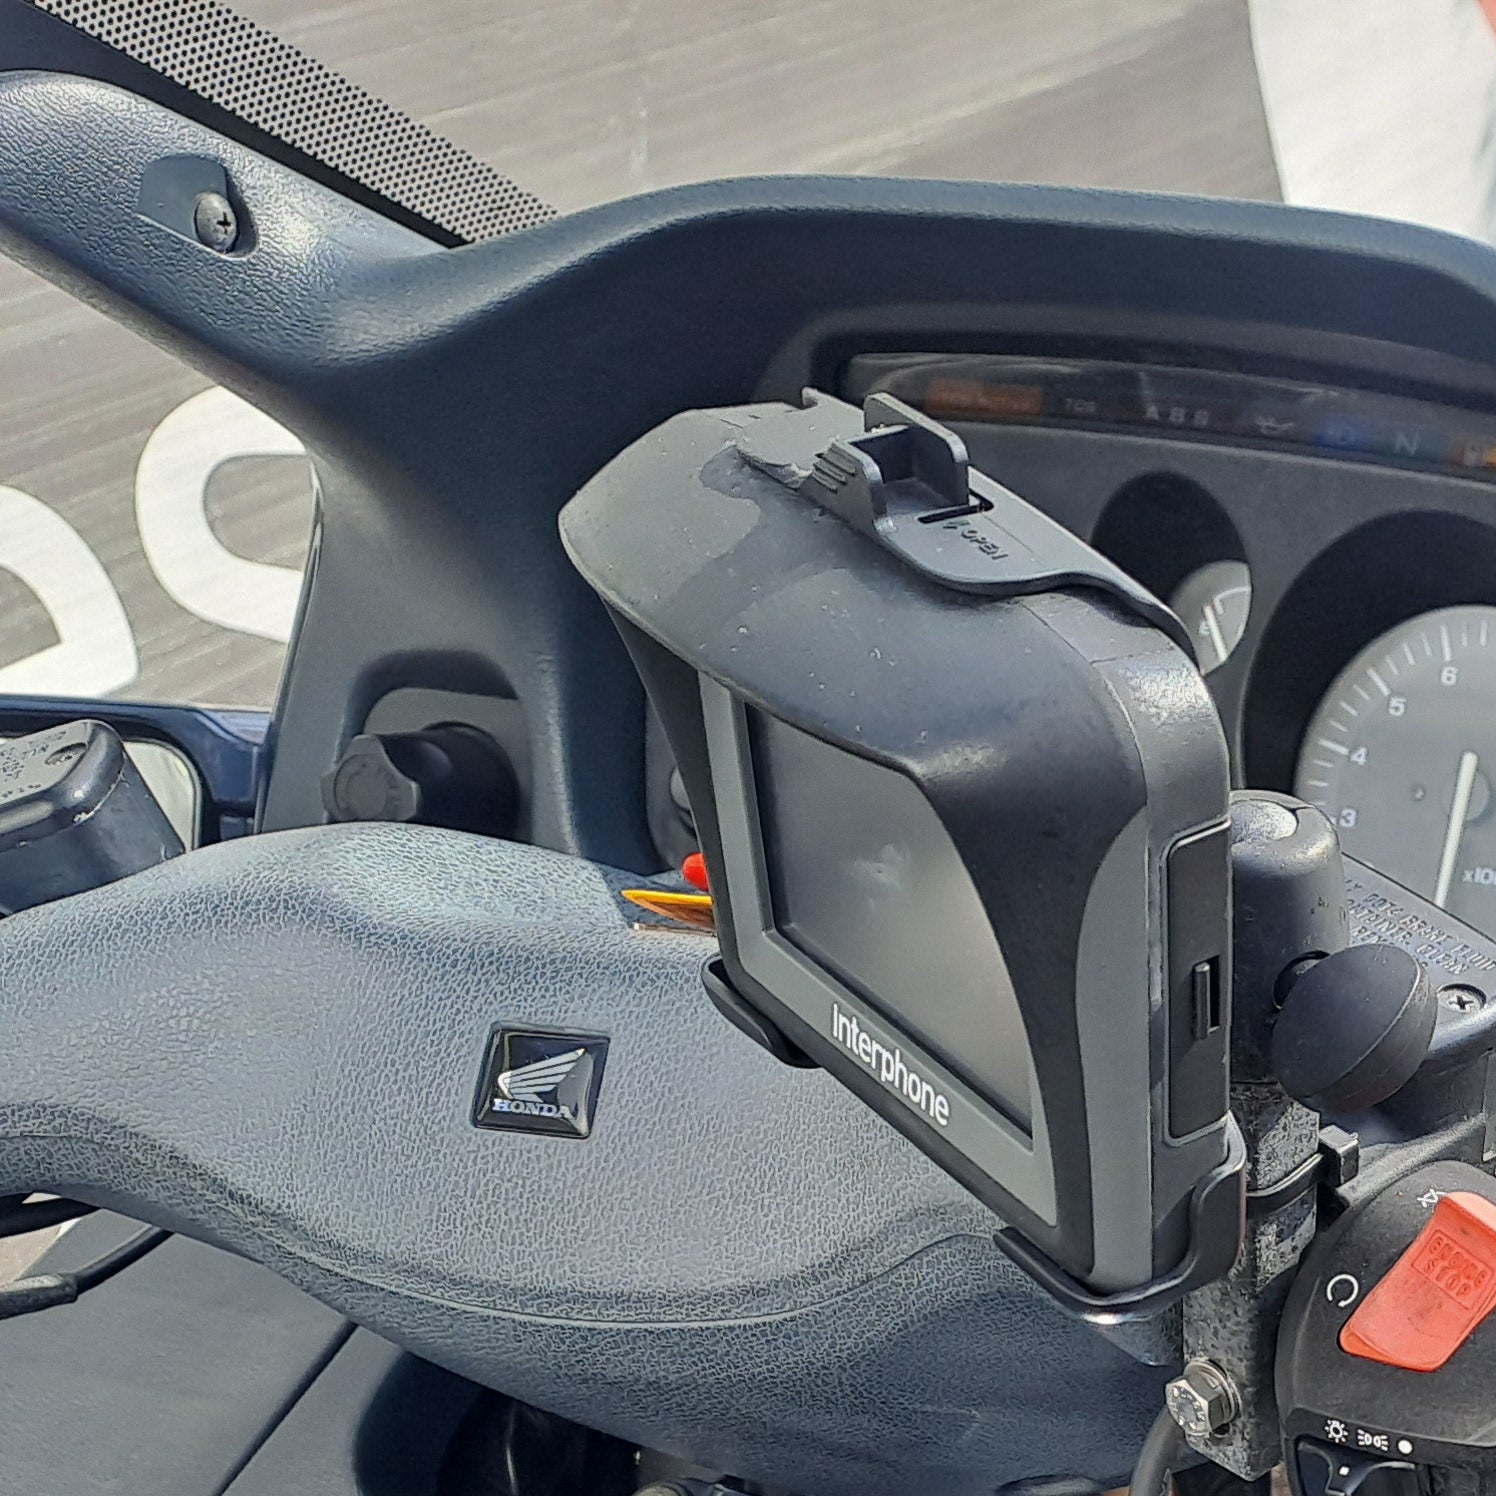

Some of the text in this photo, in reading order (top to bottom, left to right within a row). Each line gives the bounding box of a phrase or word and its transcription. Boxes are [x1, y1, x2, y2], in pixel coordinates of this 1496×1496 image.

[1440, 666, 1458, 686] 6
[1388, 697, 1407, 717] 5
[1351, 747, 1369, 766] 4
[1339, 808, 1357, 828] 3
[832, 1003, 950, 1126] Interphone
[492, 1098, 576, 1120] HONDA
[1424, 1259, 1472, 1297] STOP
